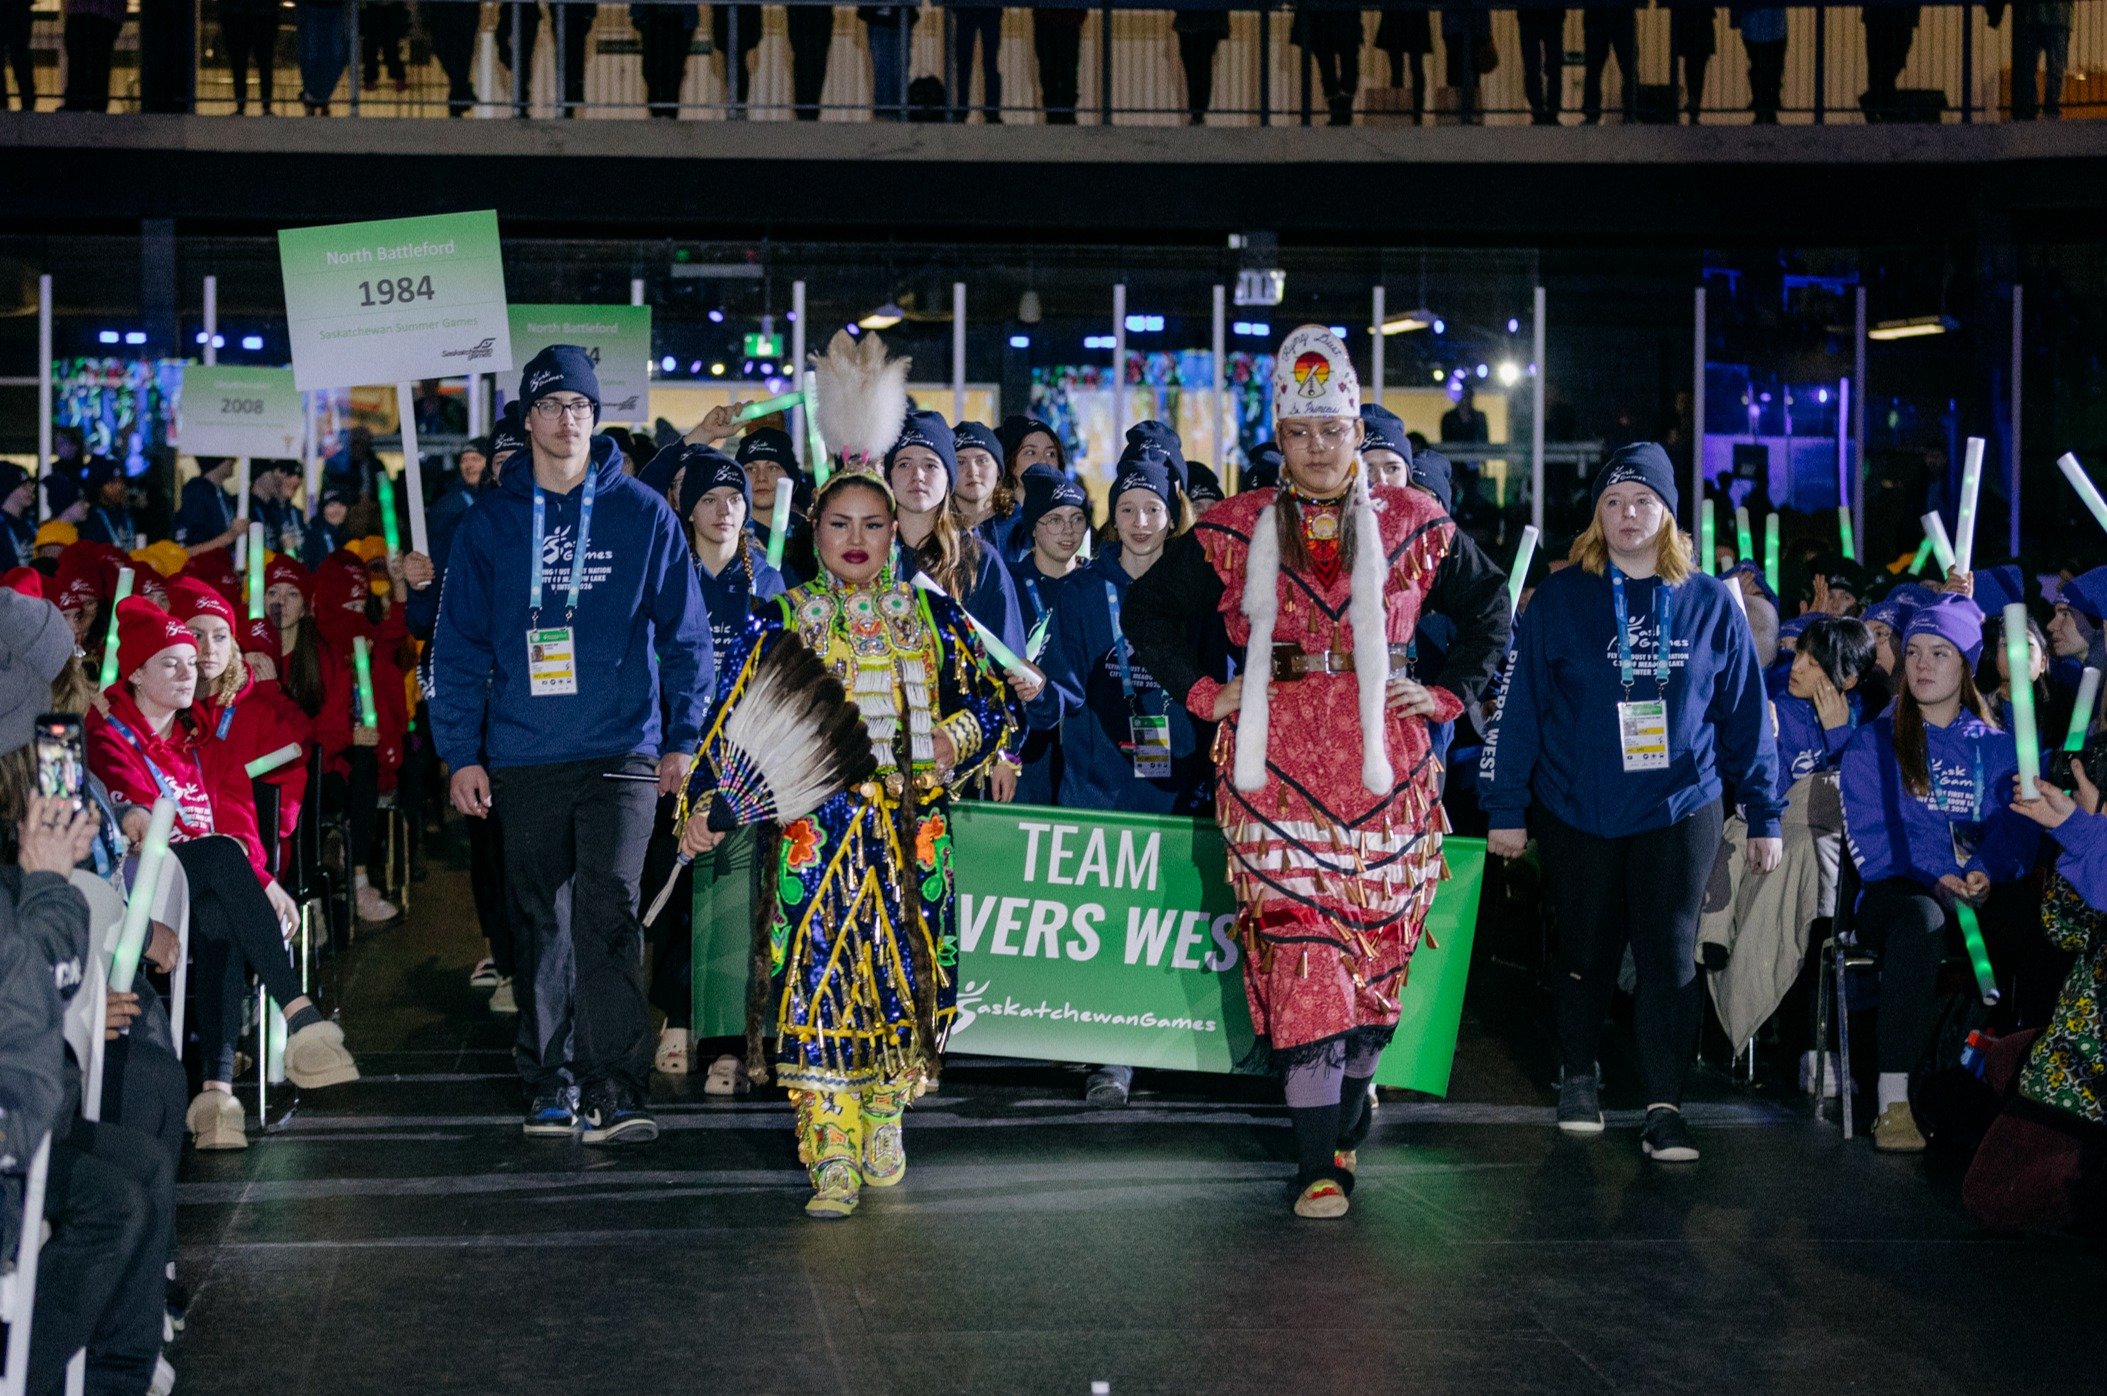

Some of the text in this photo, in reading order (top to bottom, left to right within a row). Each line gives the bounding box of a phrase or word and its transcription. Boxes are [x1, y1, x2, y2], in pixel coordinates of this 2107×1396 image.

[326, 240, 455, 265] North Battleford
[358, 275, 435, 307] 1984
[319, 316, 479, 340] Saskatchewan Summer Games
[221, 398, 264, 414] 2008
[562, 550, 614, 561] Gmes
[1479, 728, 1499, 781] WEST
[1939, 776, 1974, 787] Gam
[1018, 822, 1161, 891] TEAM
[959, 893, 1239, 972] VERS WES
[951, 980, 1217, 1035] SaskatchewanGames
